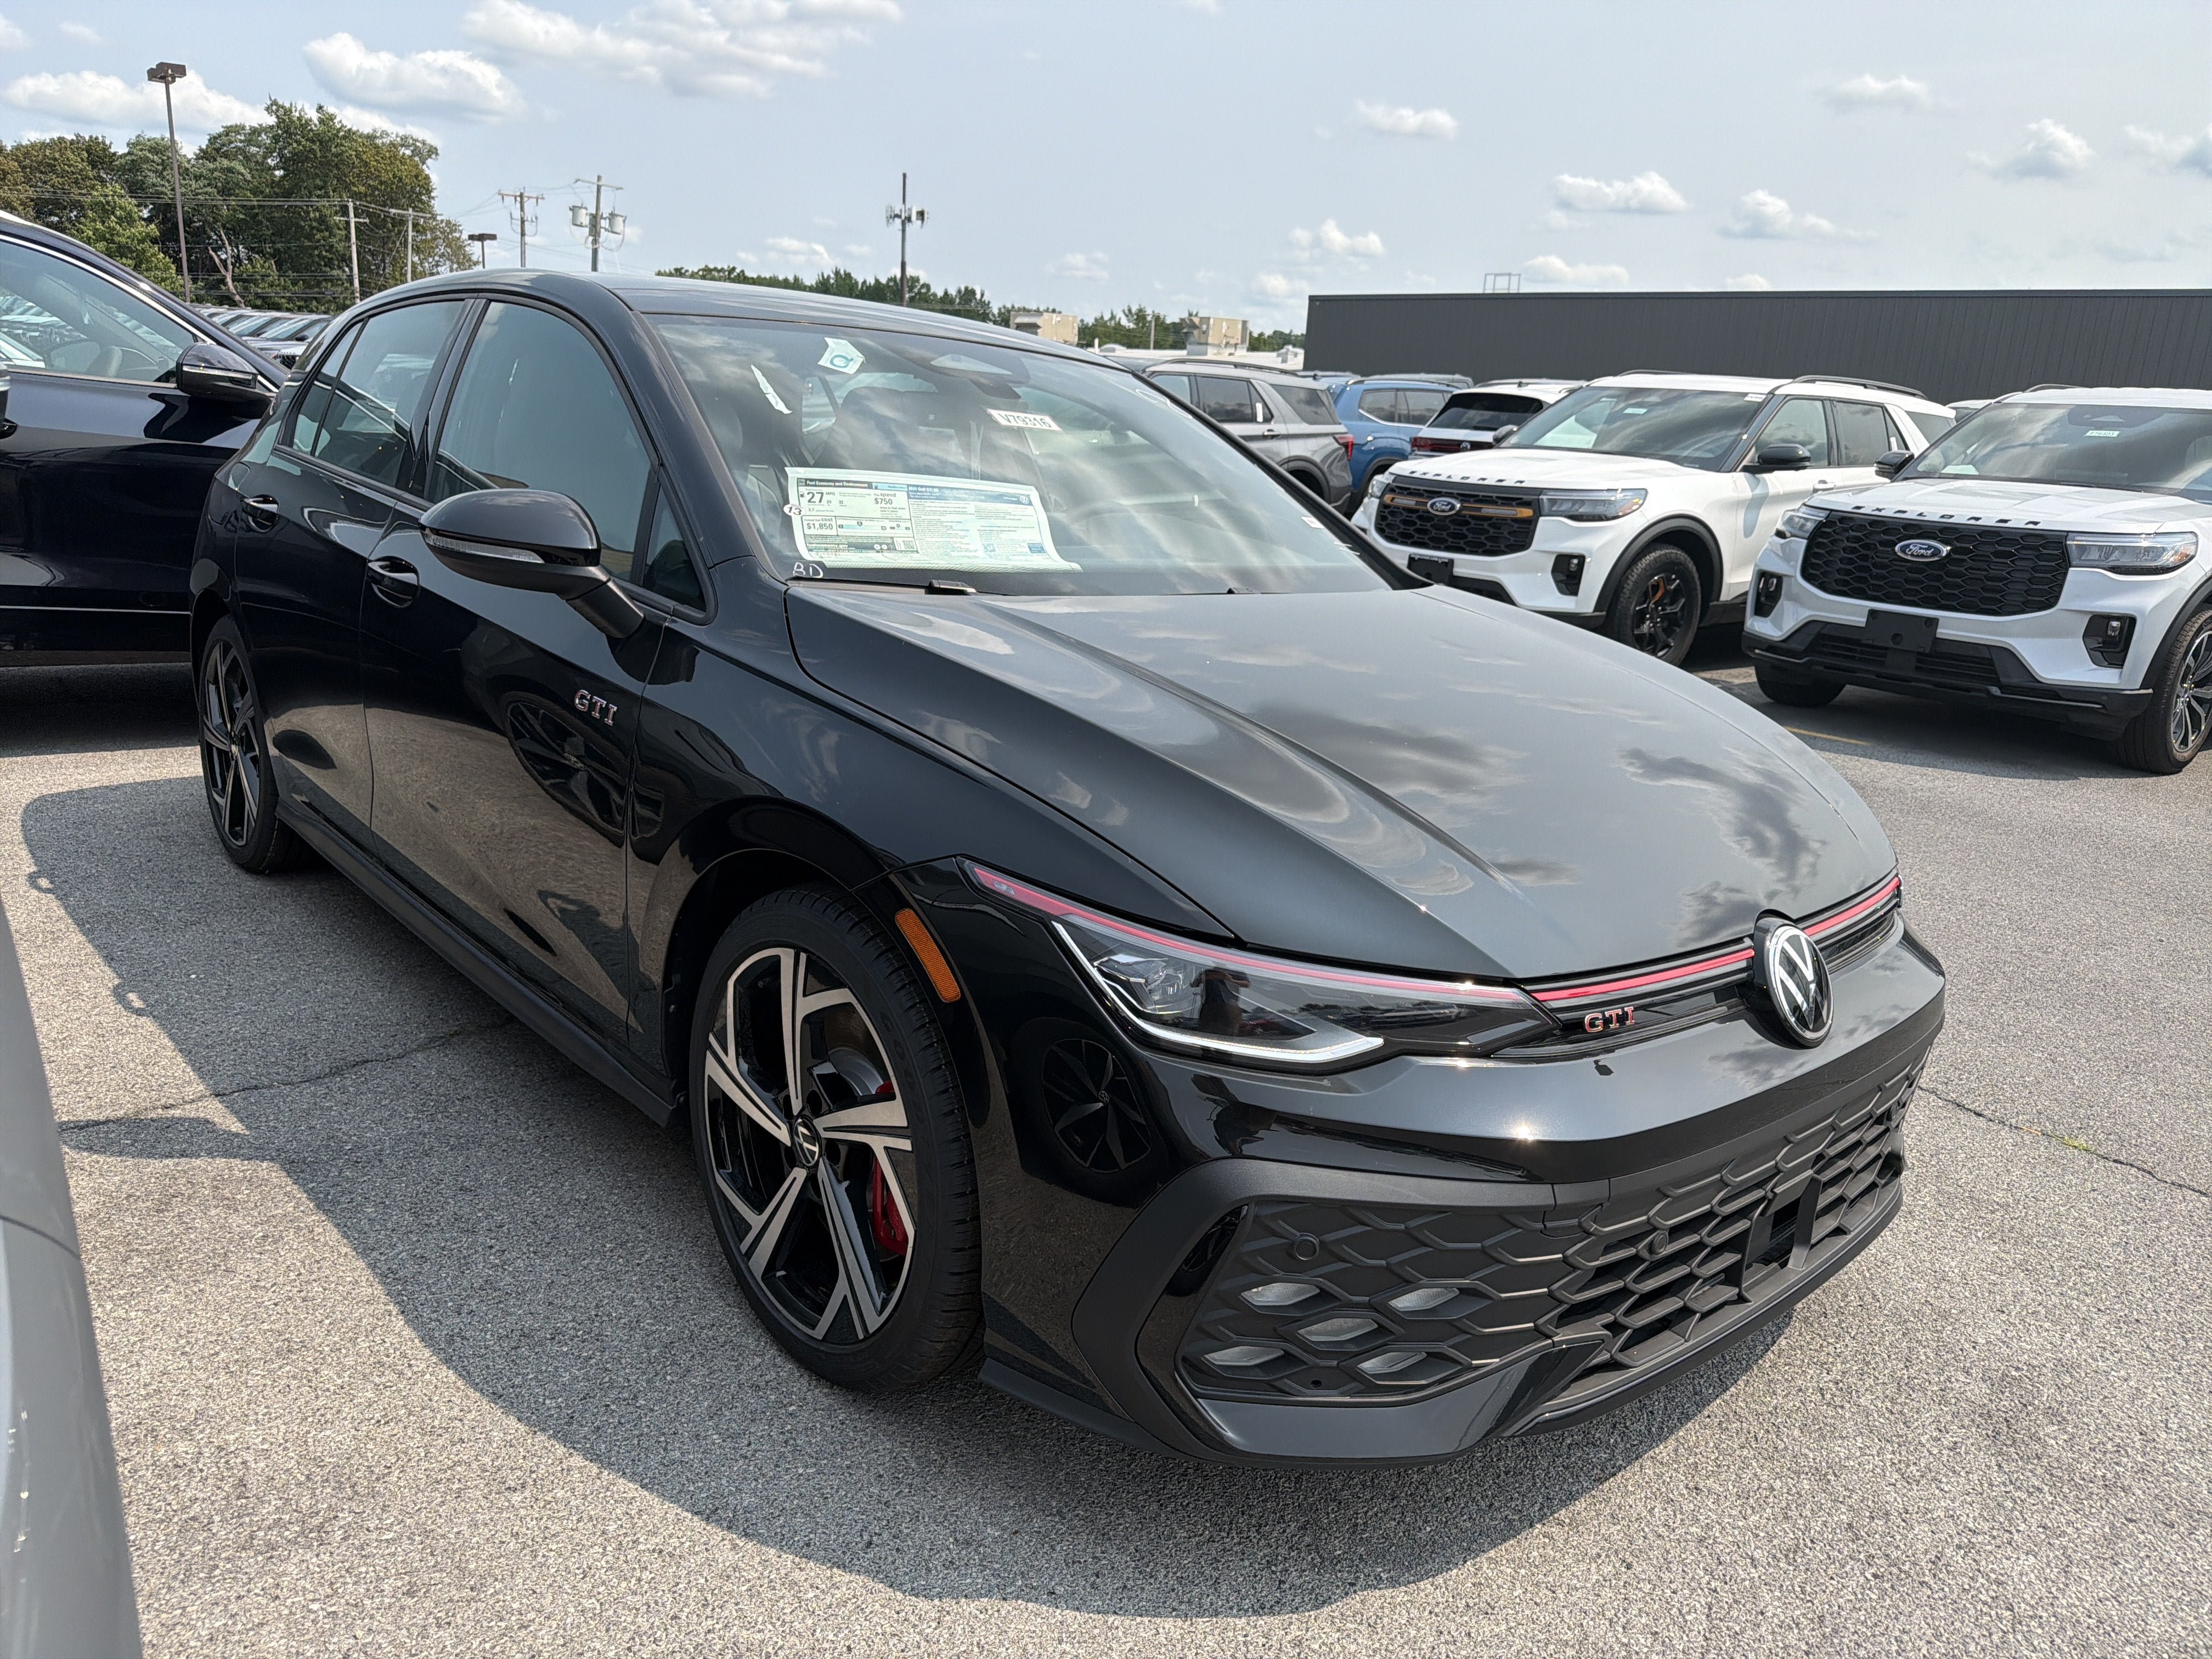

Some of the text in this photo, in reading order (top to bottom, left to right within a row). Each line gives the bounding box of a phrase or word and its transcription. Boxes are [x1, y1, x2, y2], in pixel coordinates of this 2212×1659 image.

[998, 413, 1052, 428] V79316
[806, 492, 824, 503] 27
[874, 497, 893, 505] $750
[787, 506, 803, 516] 13
[1433, 500, 1452, 511] Ford
[1852, 505, 2041, 526] EXPLORER
[1905, 544, 1934, 556] Ford
[574, 689, 618, 726] GTI
[1584, 1006, 1635, 1032] GTI
